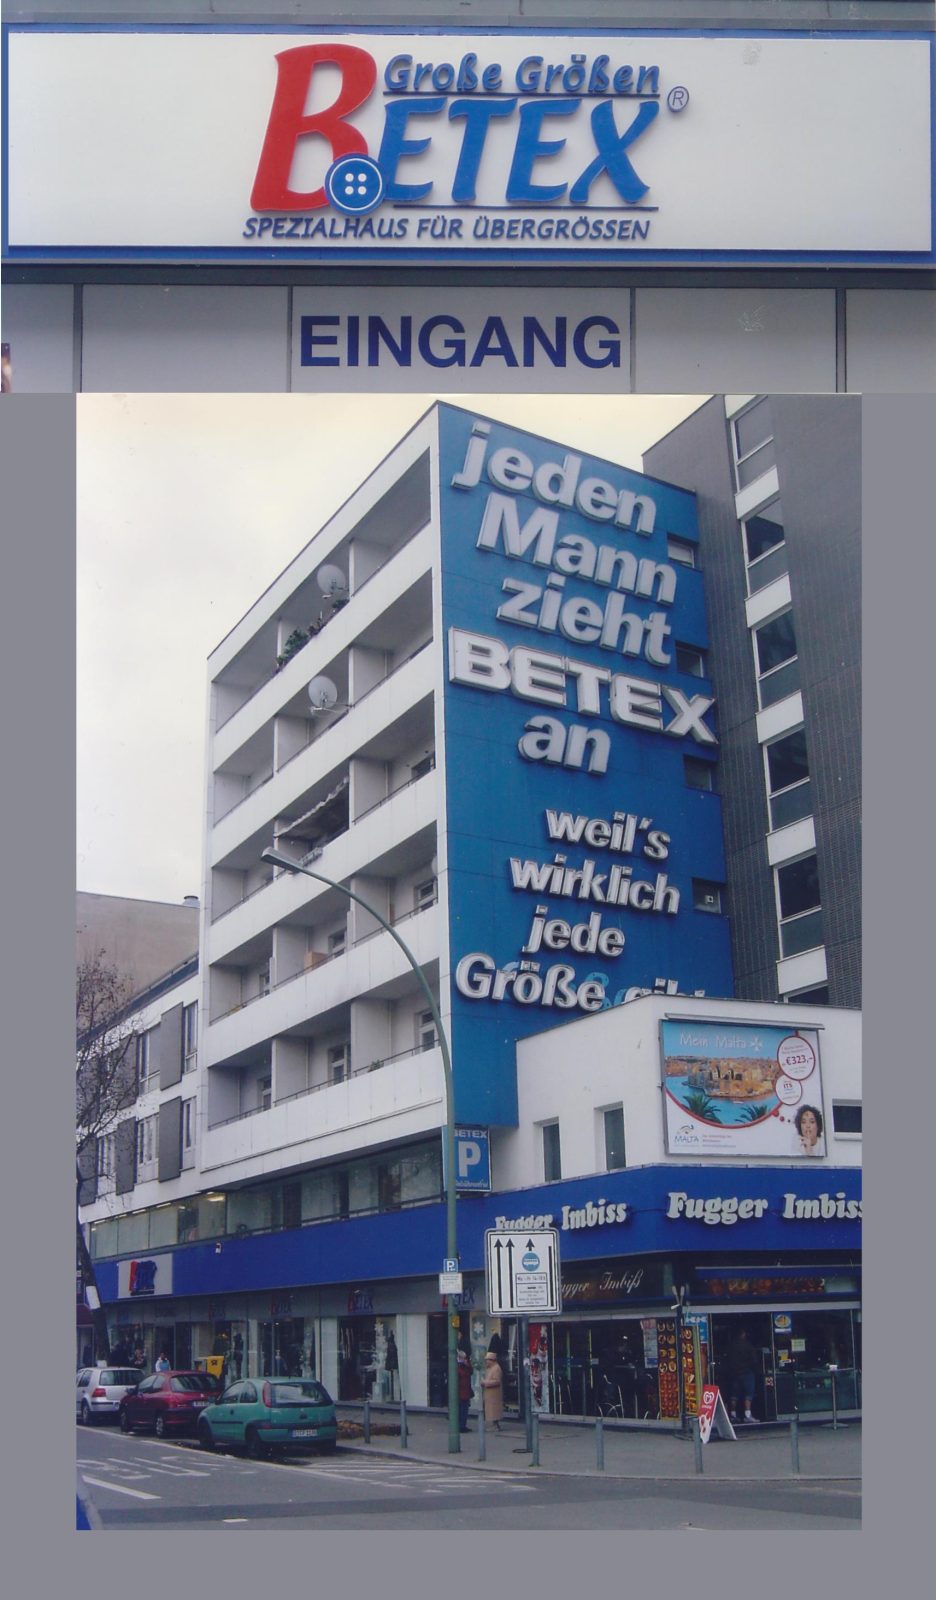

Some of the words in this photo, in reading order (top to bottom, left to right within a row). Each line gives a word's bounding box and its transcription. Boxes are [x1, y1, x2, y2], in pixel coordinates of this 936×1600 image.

[384, 54, 502, 92] Große
[515, 54, 661, 95] Größen
[250, 43, 660, 213] BETEX
[242, 216, 408, 240] SPEZIALHAUS
[416, 214, 463, 240] FÜR
[472, 215, 650, 241] ÜBERGRÖSSEN
[300, 315, 622, 369] EINGANG
[451, 421, 657, 537] jeden
[476, 492, 677, 605] Mann
[496, 573, 671, 667] zieht
[448, 626, 719, 745] BETEX
[518, 715, 611, 774] an
[509, 853, 680, 914] wirklich
[522, 904, 625, 957] jede
[455, 952, 606, 1012] Größe
[680, 1032, 709, 1048] Mein
[715, 1034, 747, 1049] Malta
[458, 1140, 481, 1177] P
[561, 1199, 628, 1231] Imbiss
[666, 1192, 769, 1225] Fugger
[559, 1276, 591, 1299] ugger
[599, 1268, 644, 1294] Imbiß
